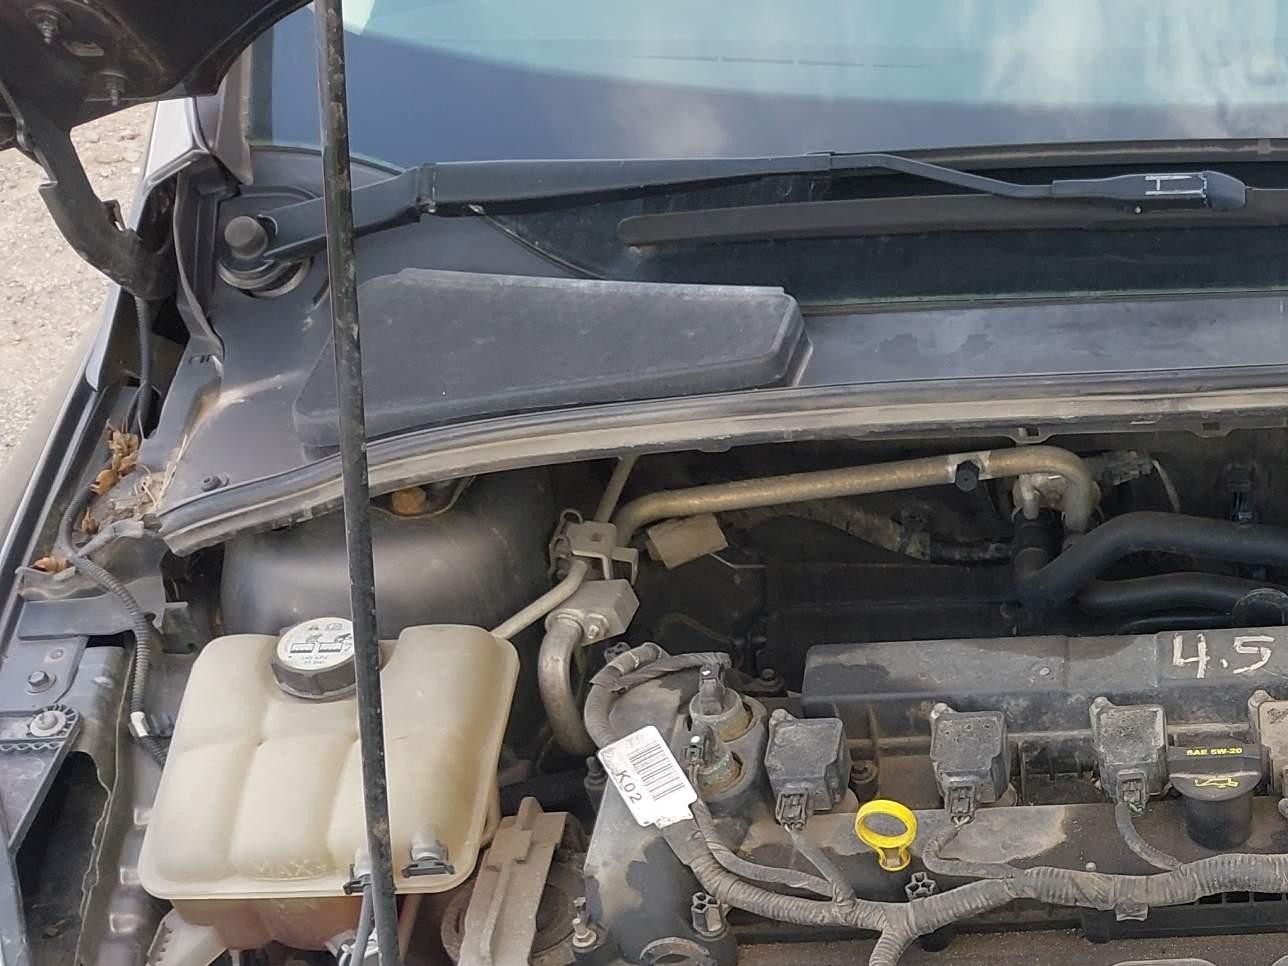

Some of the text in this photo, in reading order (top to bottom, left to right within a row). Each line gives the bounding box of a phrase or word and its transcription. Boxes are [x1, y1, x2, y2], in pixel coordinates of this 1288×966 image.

[1172, 632, 1275, 679] 4.5
[1210, 747, 1243, 756] 5W-20
[615, 770, 643, 804] K02
